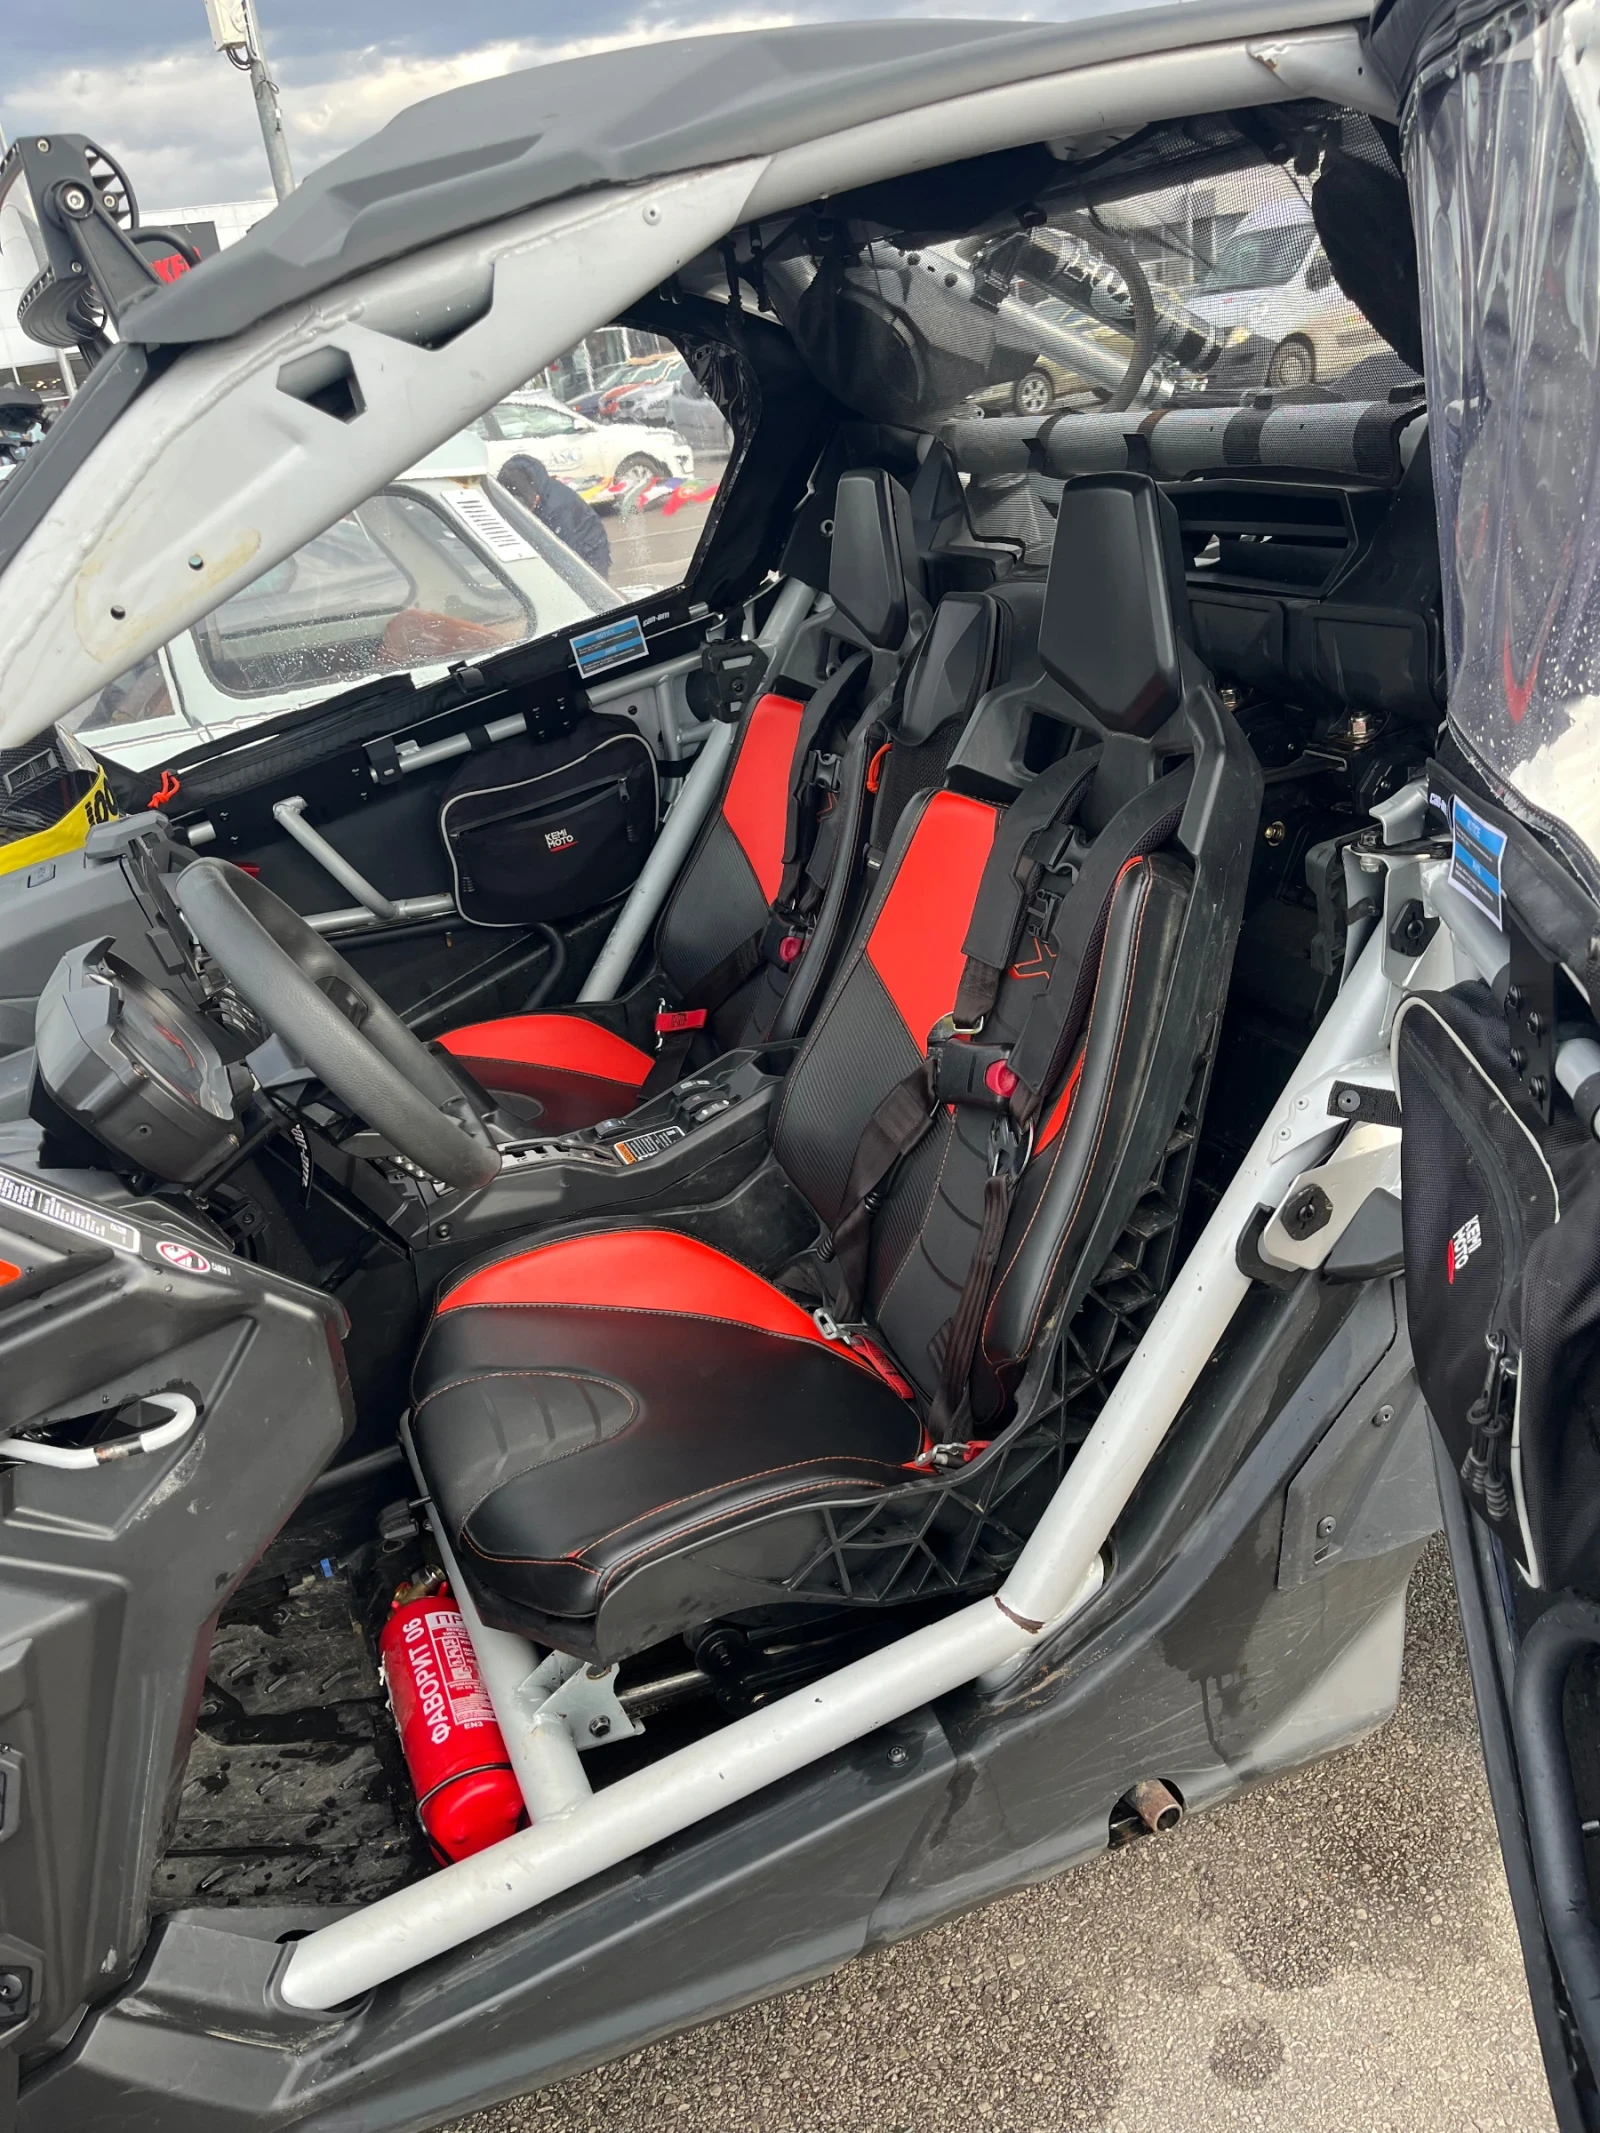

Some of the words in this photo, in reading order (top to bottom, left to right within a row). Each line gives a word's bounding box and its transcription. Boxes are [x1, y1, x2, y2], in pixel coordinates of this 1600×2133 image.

[544, 828, 568, 841] KEMI
[546, 834, 574, 849] MOTO
[1464, 1214, 1482, 1254] KEMI
[1452, 1225, 1469, 1270] MOTO
[402, 1617, 426, 1643] 06
[408, 1643, 451, 1745] ФАВОРИТ
[463, 1721, 484, 1730] EN3
